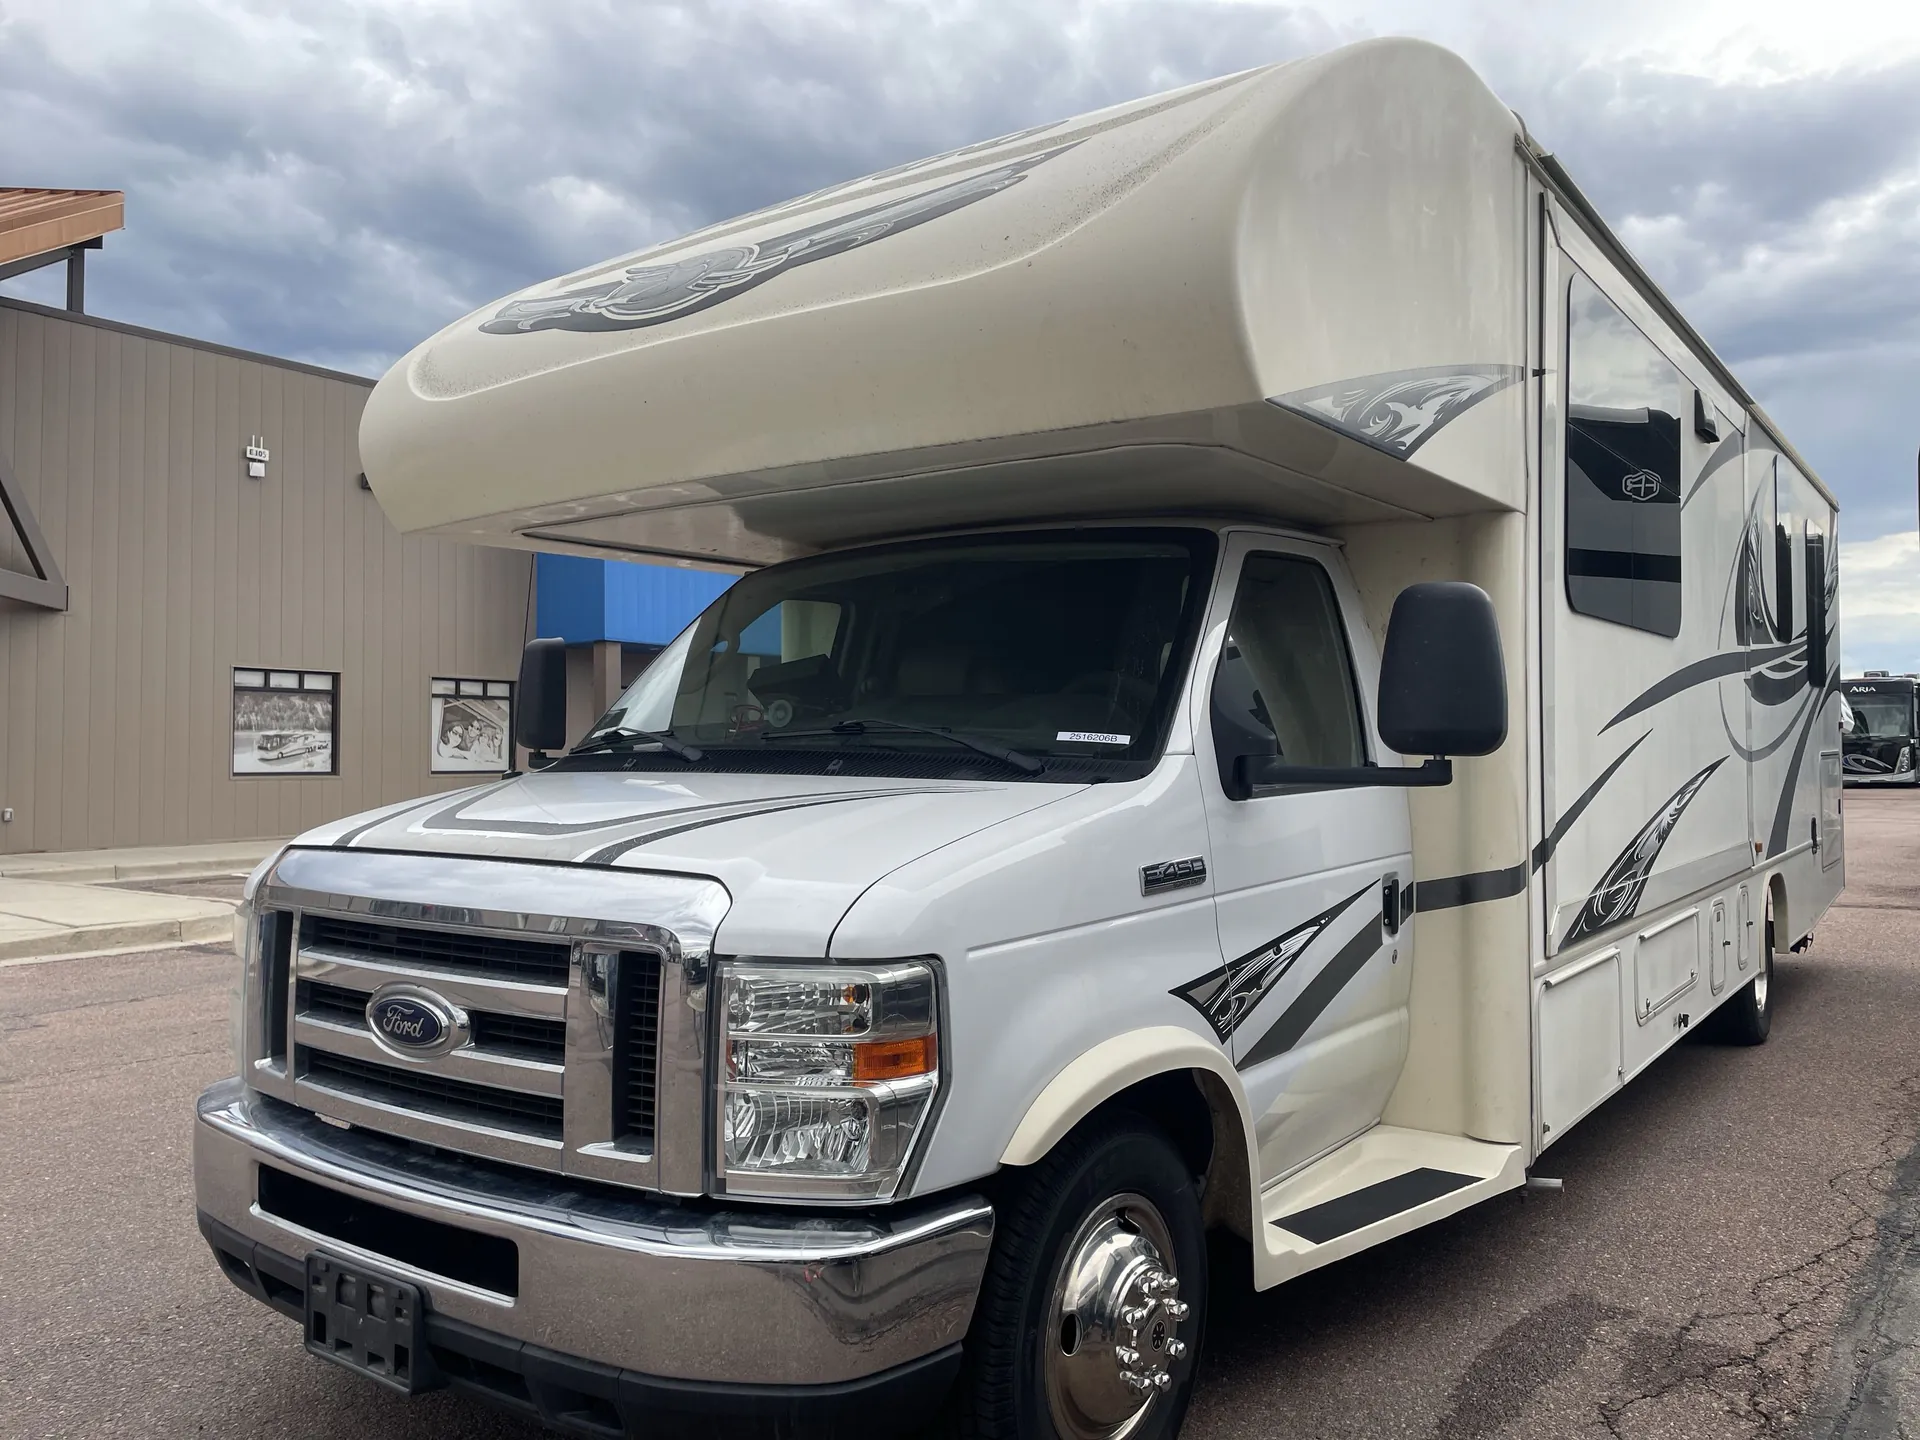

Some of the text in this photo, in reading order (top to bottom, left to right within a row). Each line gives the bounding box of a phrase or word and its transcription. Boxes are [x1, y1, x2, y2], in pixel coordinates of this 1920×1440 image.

[1850, 685, 1876, 693] ARIA
[1068, 732, 1117, 742] 2516206B
[383, 1004, 424, 1038] Ford
